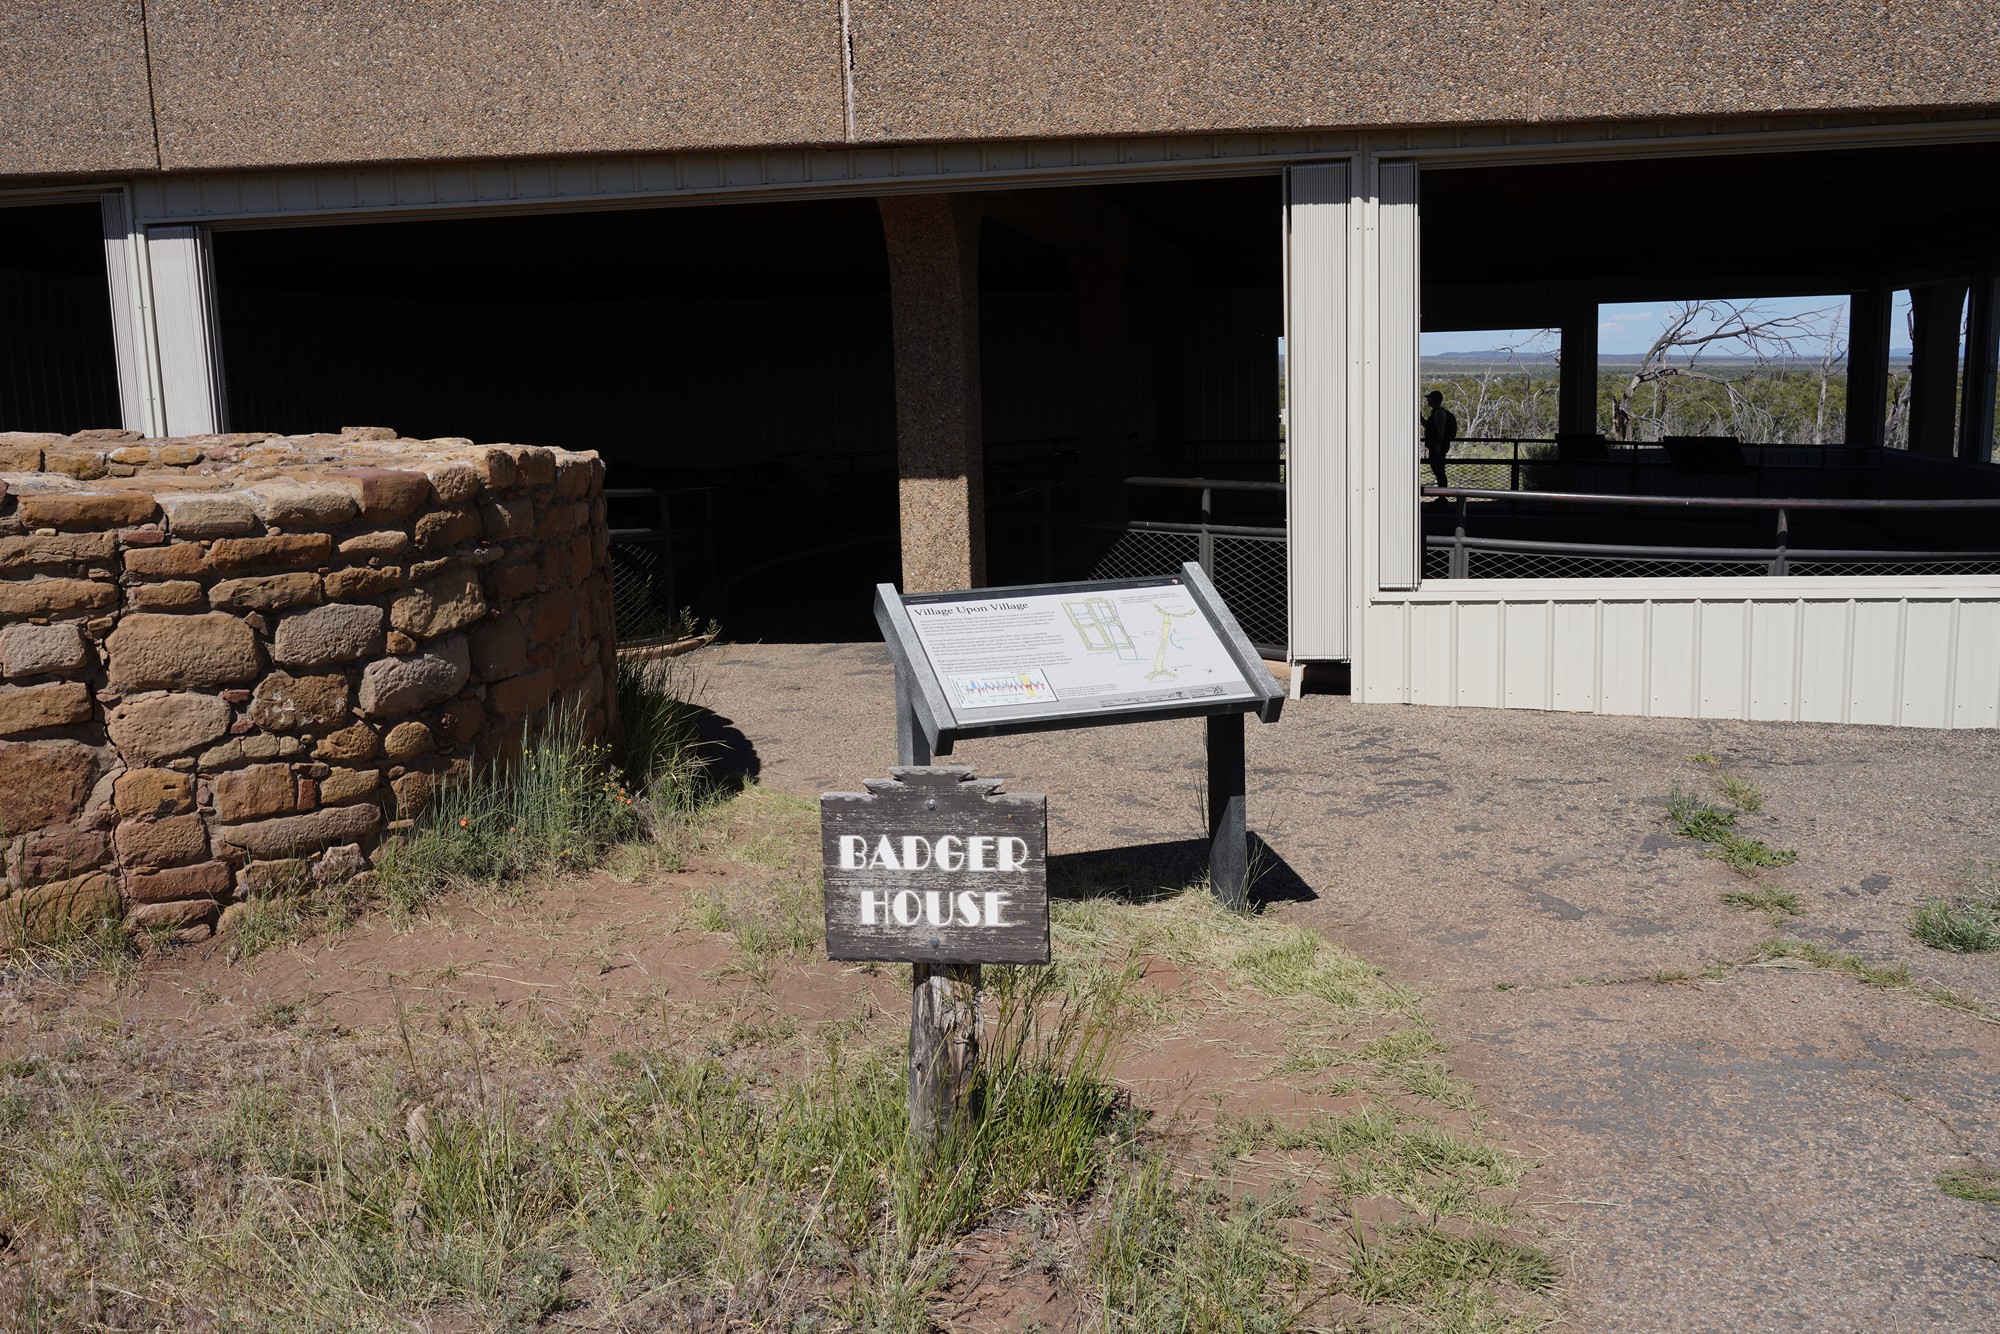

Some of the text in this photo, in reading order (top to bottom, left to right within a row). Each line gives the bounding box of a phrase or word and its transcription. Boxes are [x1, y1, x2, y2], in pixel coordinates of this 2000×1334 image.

[914, 602, 1029, 617] Village Upon Village
[839, 834, 1029, 873] BADGER
[860, 889, 1012, 928] HOUSE
